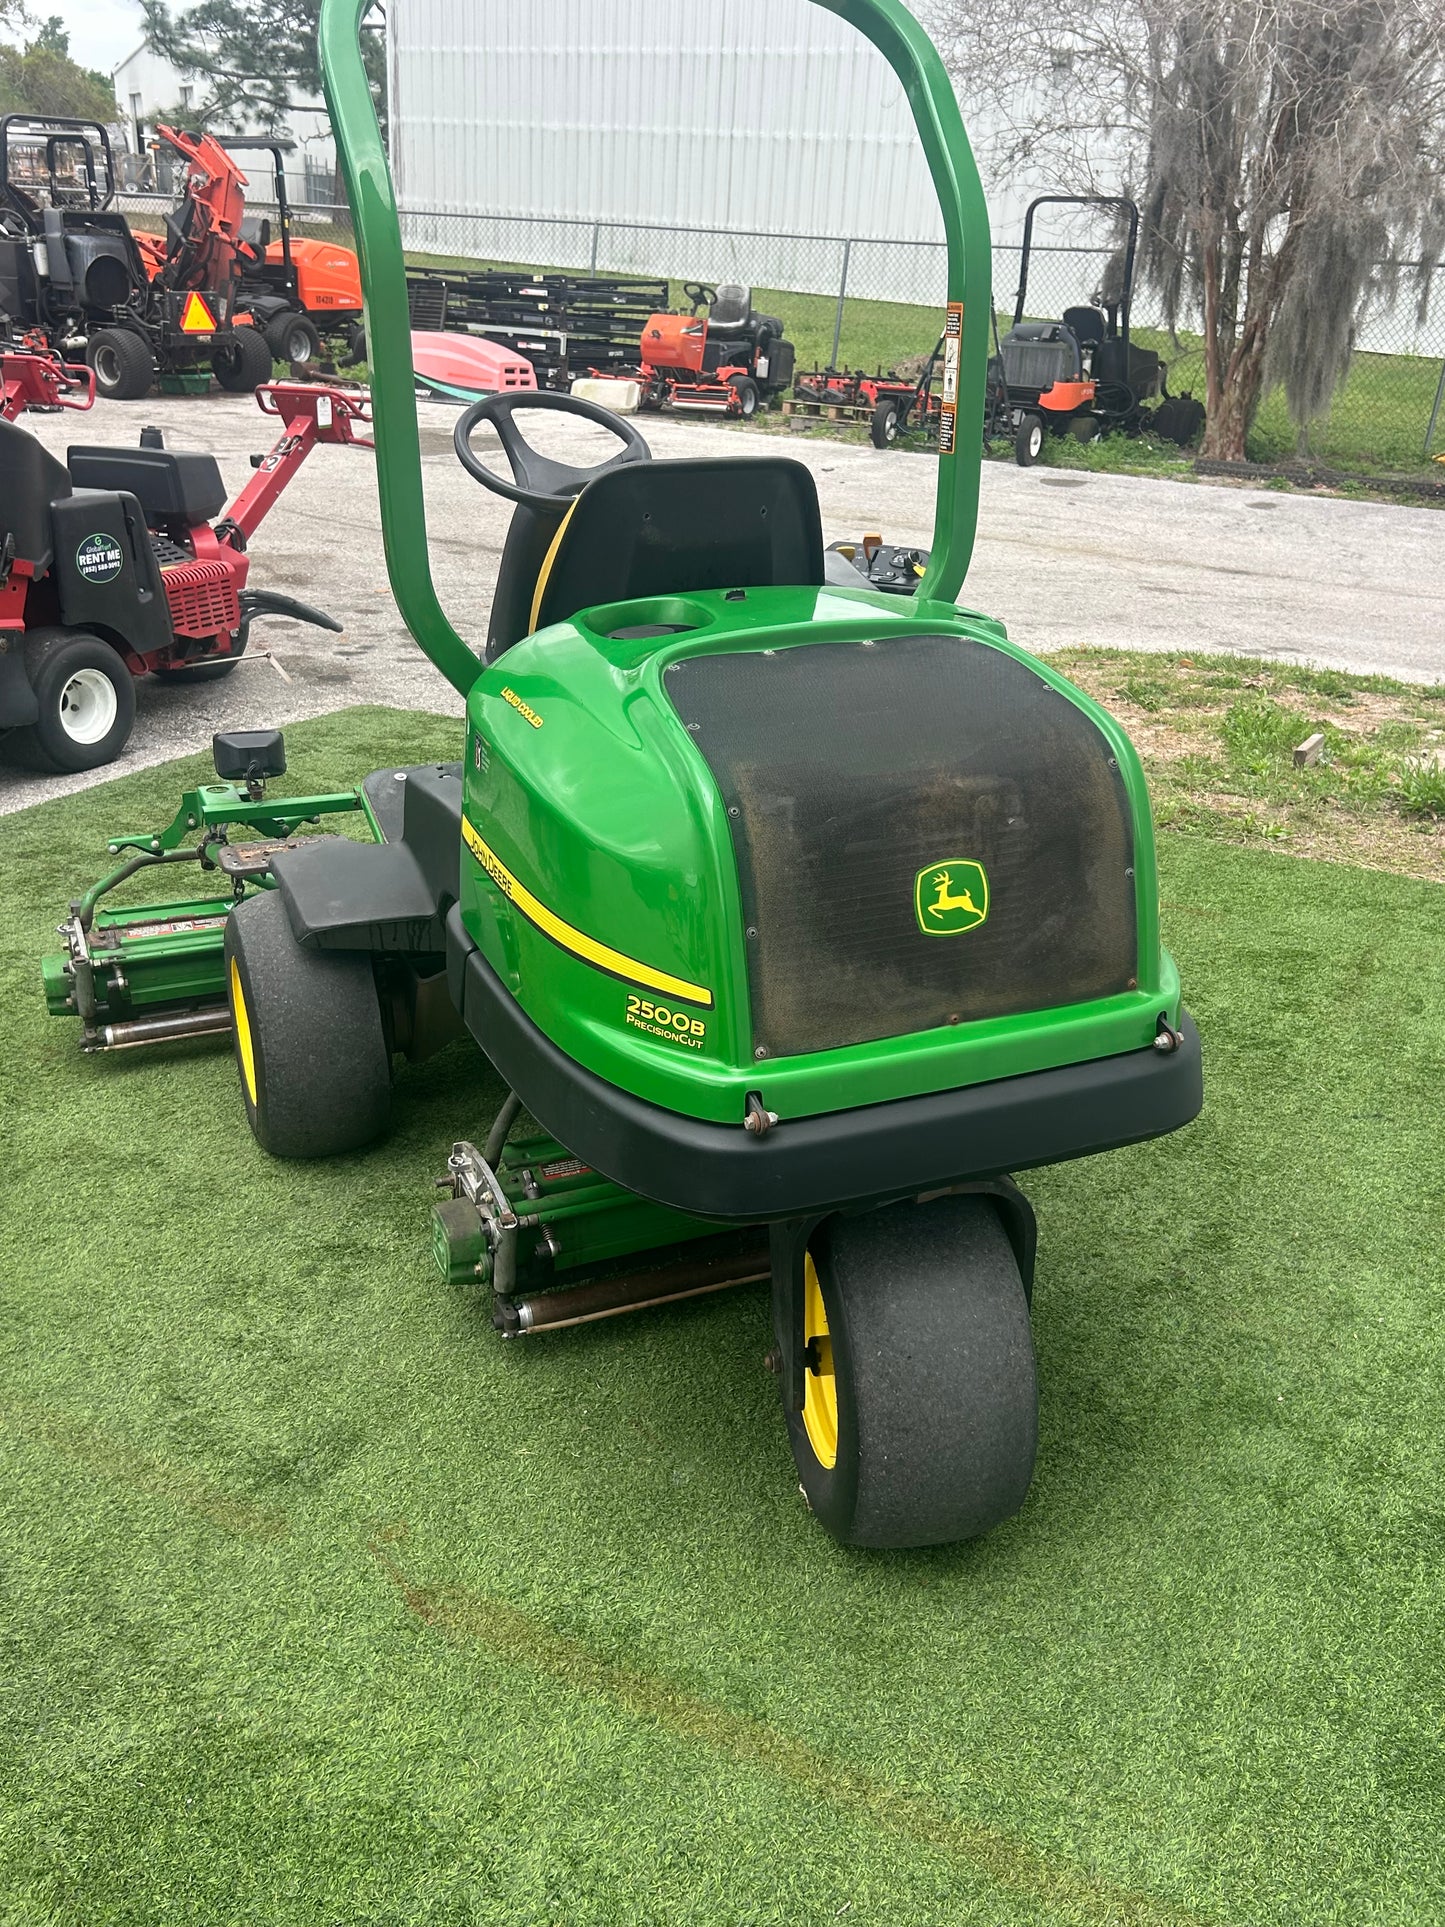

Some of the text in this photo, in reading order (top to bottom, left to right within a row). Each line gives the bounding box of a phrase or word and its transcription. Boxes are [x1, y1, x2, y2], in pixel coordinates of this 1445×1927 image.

[79, 549, 121, 566] RENT ME
[500, 686, 544, 728] LIQUID COOLED
[470, 833, 513, 897] JOHN DEERE
[627, 995, 705, 1036] 2500B
